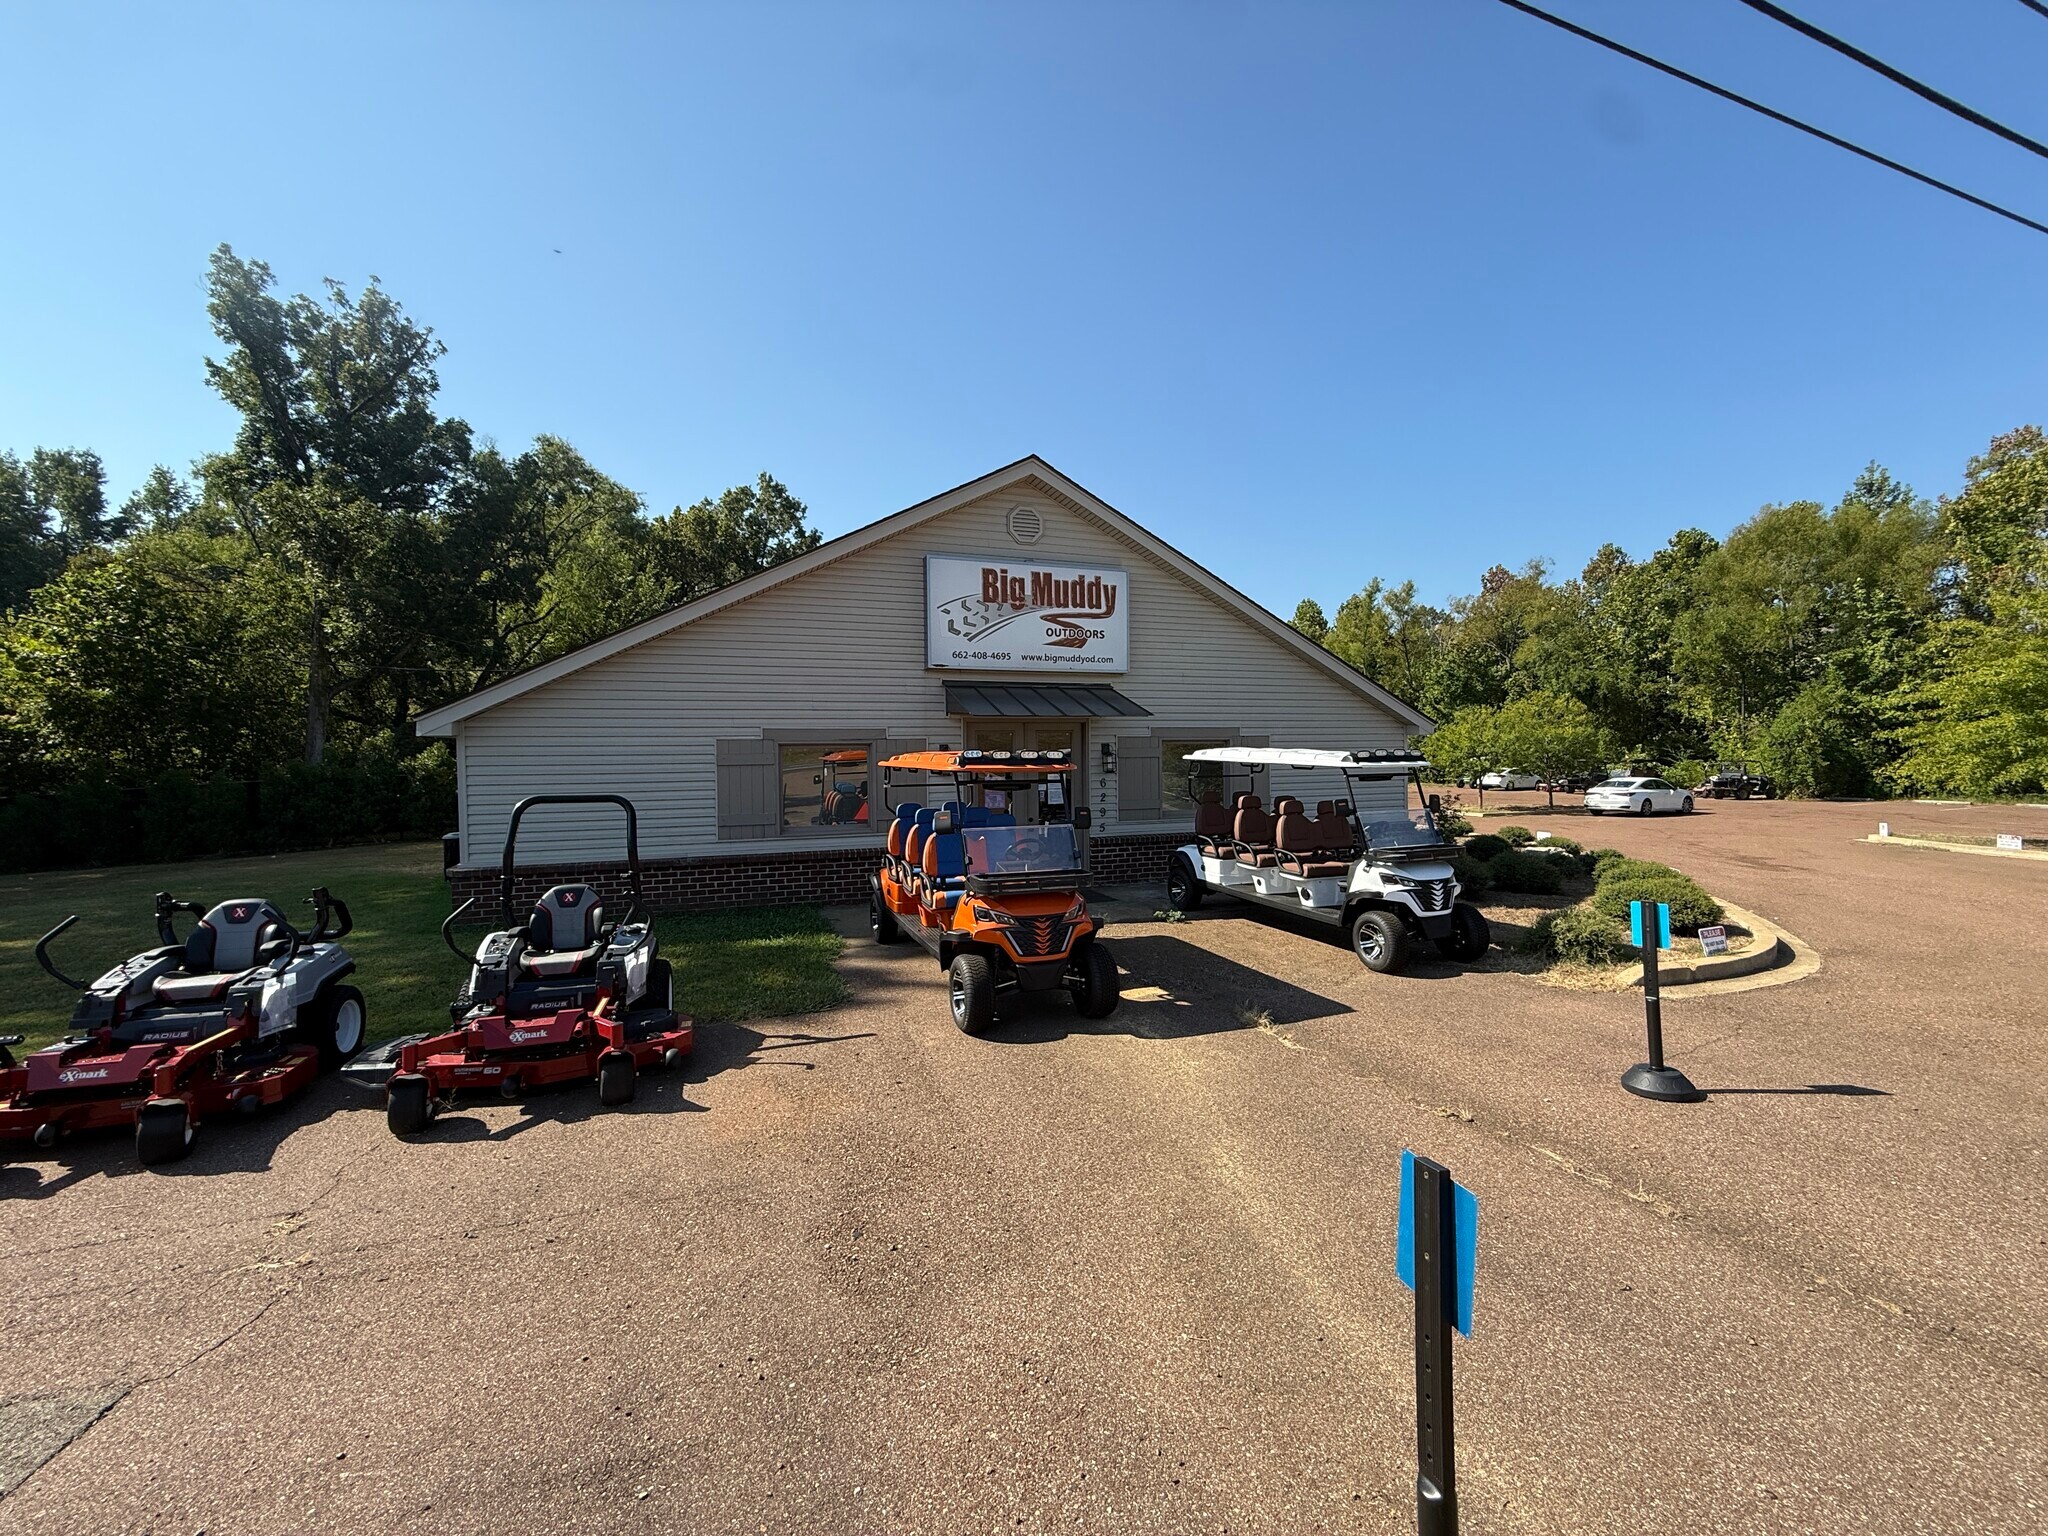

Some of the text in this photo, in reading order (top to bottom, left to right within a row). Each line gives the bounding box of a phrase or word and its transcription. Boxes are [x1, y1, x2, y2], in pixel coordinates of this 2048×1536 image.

[982, 567, 1117, 615] Big Muddy
[1046, 627, 1105, 639] OUTDOORS
[952, 650, 1114, 664] 662-408-4695 www.bigmuddyod.com
[1703, 929, 1721, 937] PLEASE
[530, 1001, 569, 1010] RADIUS
[142, 1031, 190, 1041] RADIUS
